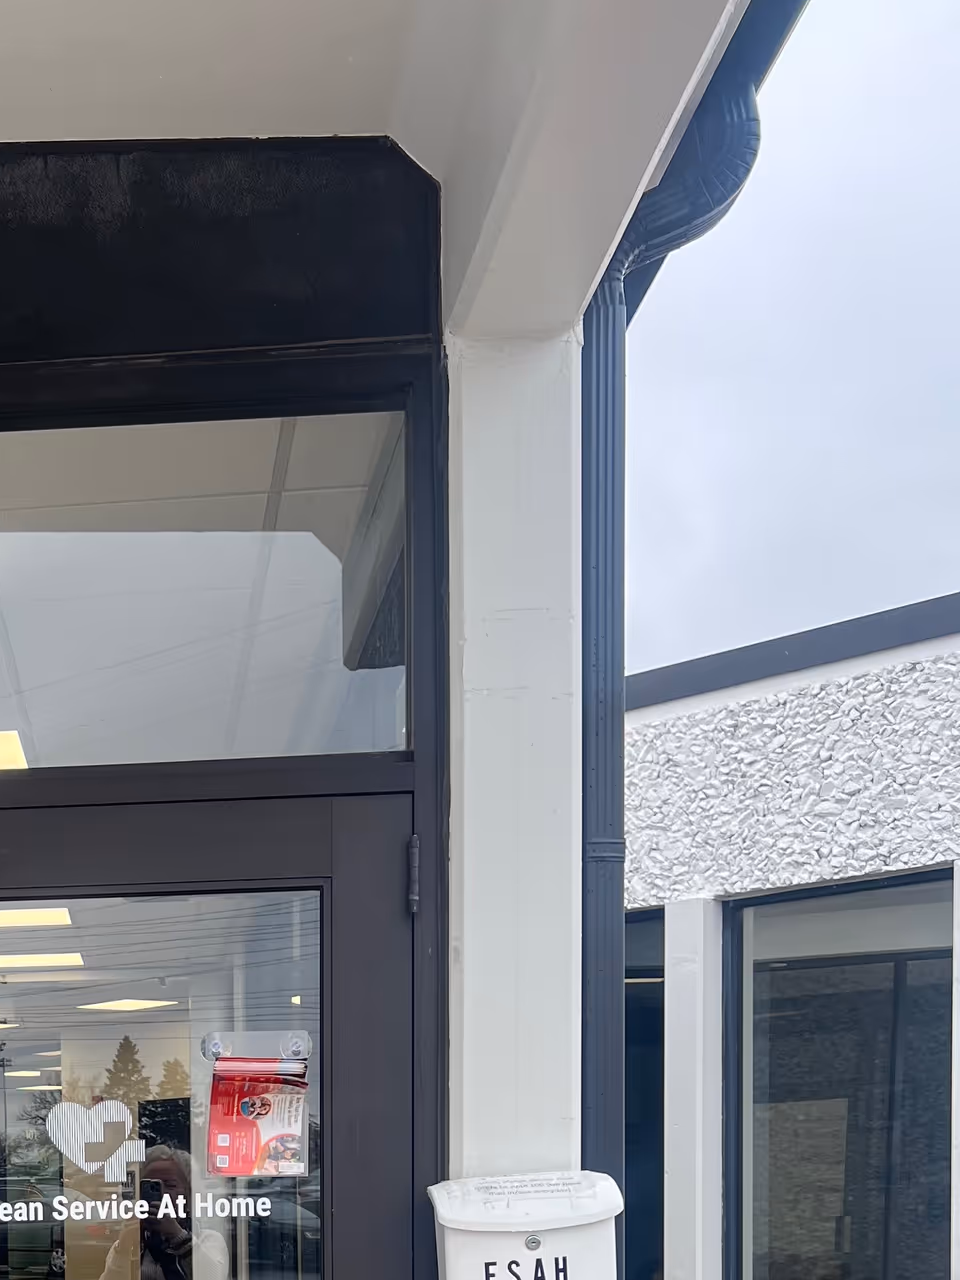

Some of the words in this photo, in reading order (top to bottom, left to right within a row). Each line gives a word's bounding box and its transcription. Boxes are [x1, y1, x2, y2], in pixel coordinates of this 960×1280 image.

[52, 1194, 150, 1221] Service
[157, 1194, 186, 1219] At
[195, 1193, 271, 1218] Home
